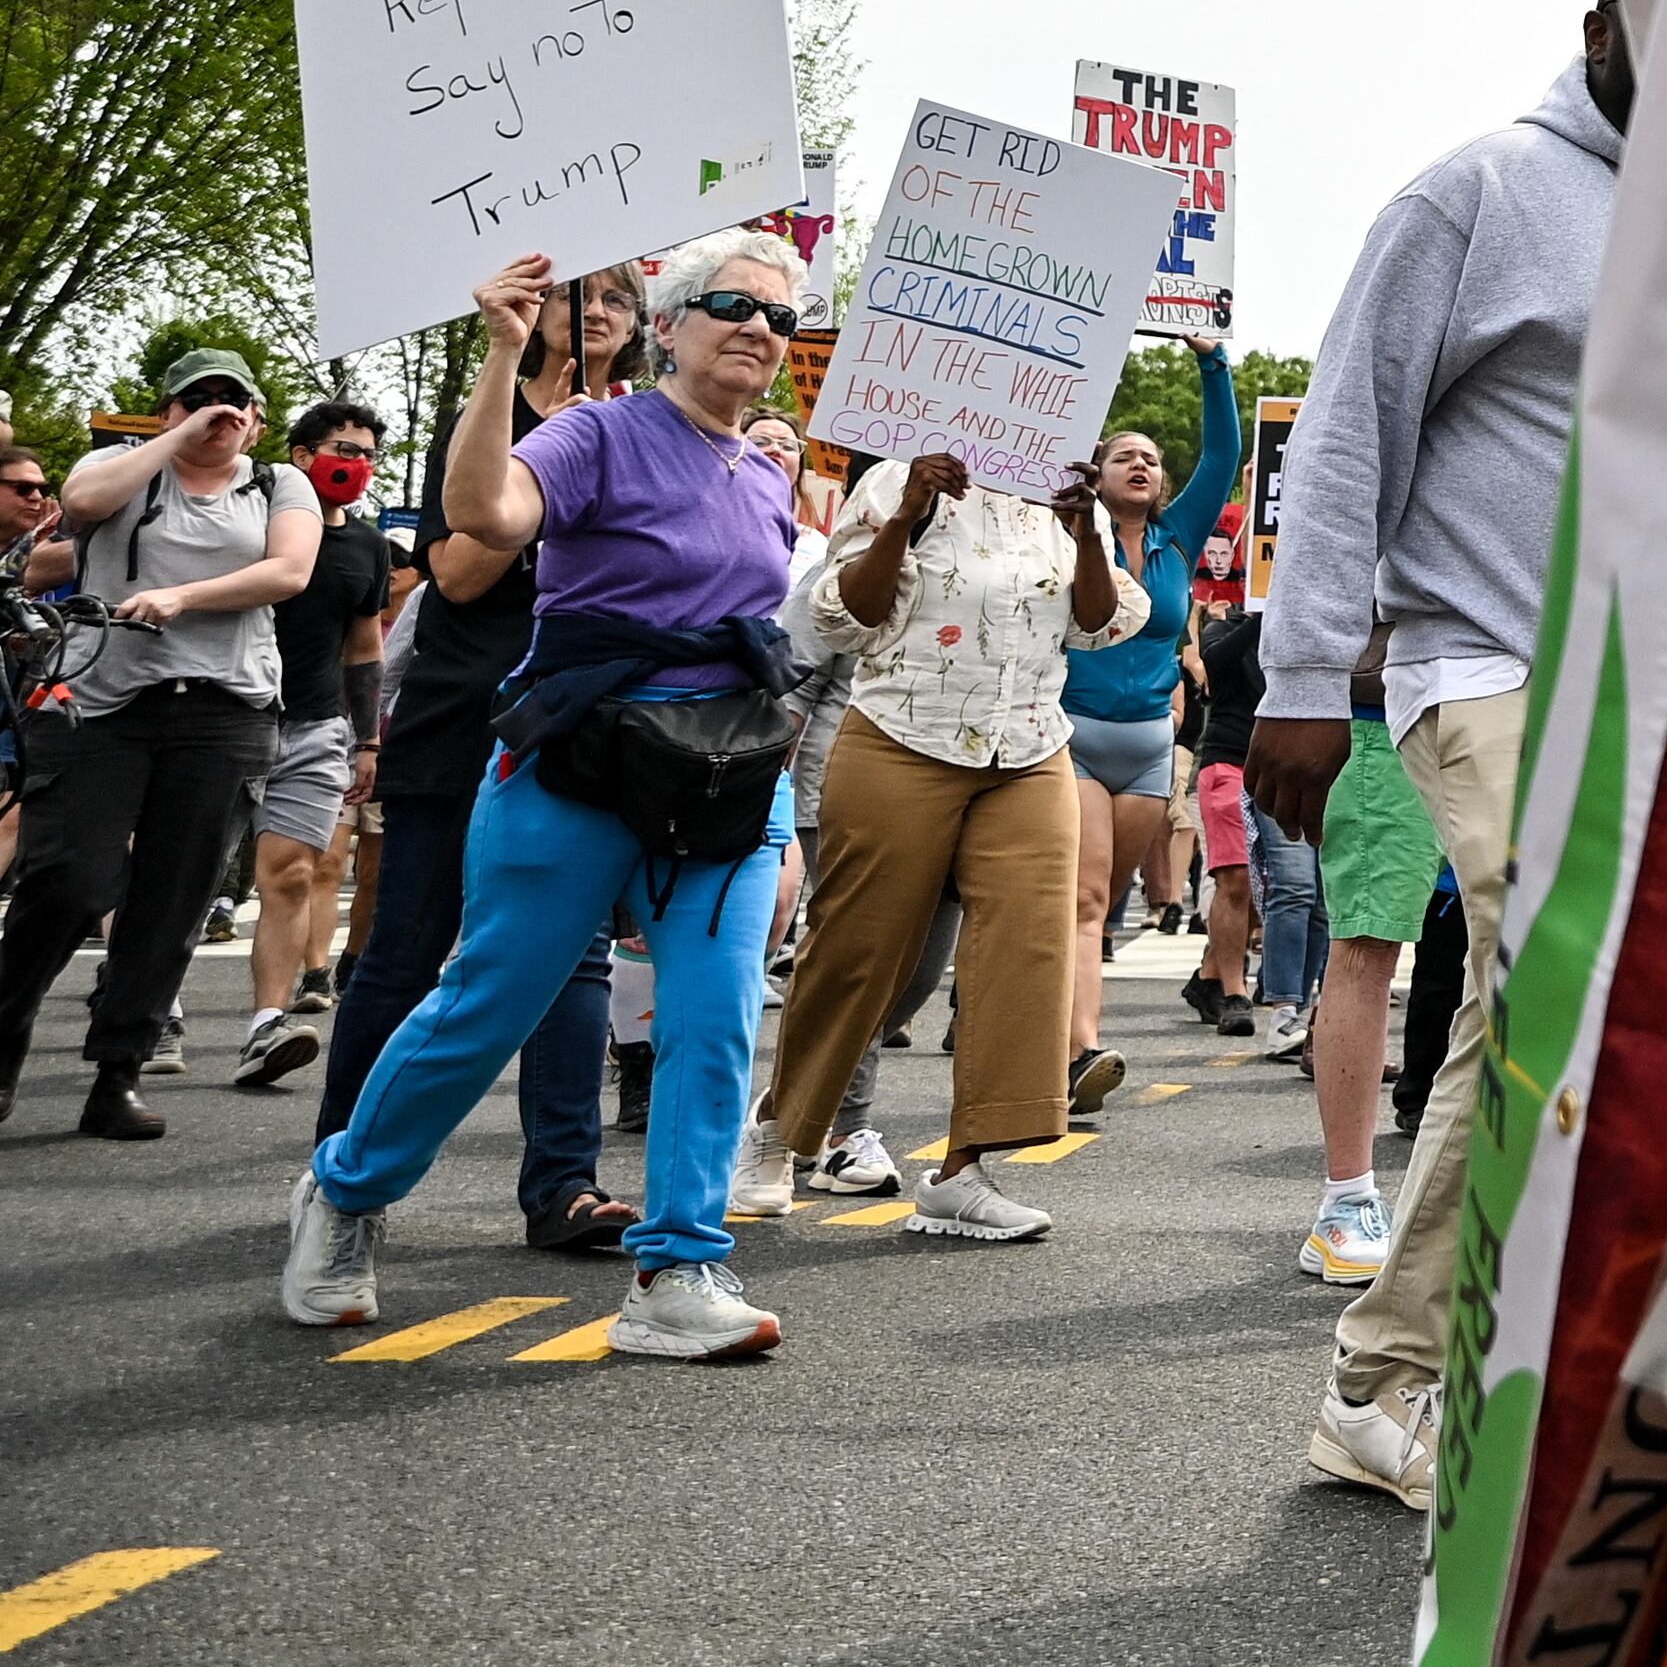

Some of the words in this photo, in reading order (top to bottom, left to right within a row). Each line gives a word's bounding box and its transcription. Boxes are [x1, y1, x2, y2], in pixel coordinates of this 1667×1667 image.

[405, 55, 523, 139] Say
[532, 31, 585, 66] no
[1113, 68, 1199, 115] THE
[803, 162, 828, 170] RUMP
[916, 112, 990, 158] GET
[999, 131, 1061, 177] RID
[1075, 96, 1232, 168] TRUMP
[431, 142, 641, 236] Trump
[901, 165, 962, 207] OF
[969, 182, 1040, 233] THE
[868, 267, 1088, 356] CRIMINALS
[792, 349, 805, 366] In
[851, 319, 924, 372] IN
[932, 338, 1009, 390] THE
[830, 410, 916, 453] GOP
[845, 374, 943, 424] HOUSE
[947, 406, 1006, 441] AND
[1011, 423, 1066, 466] THE
